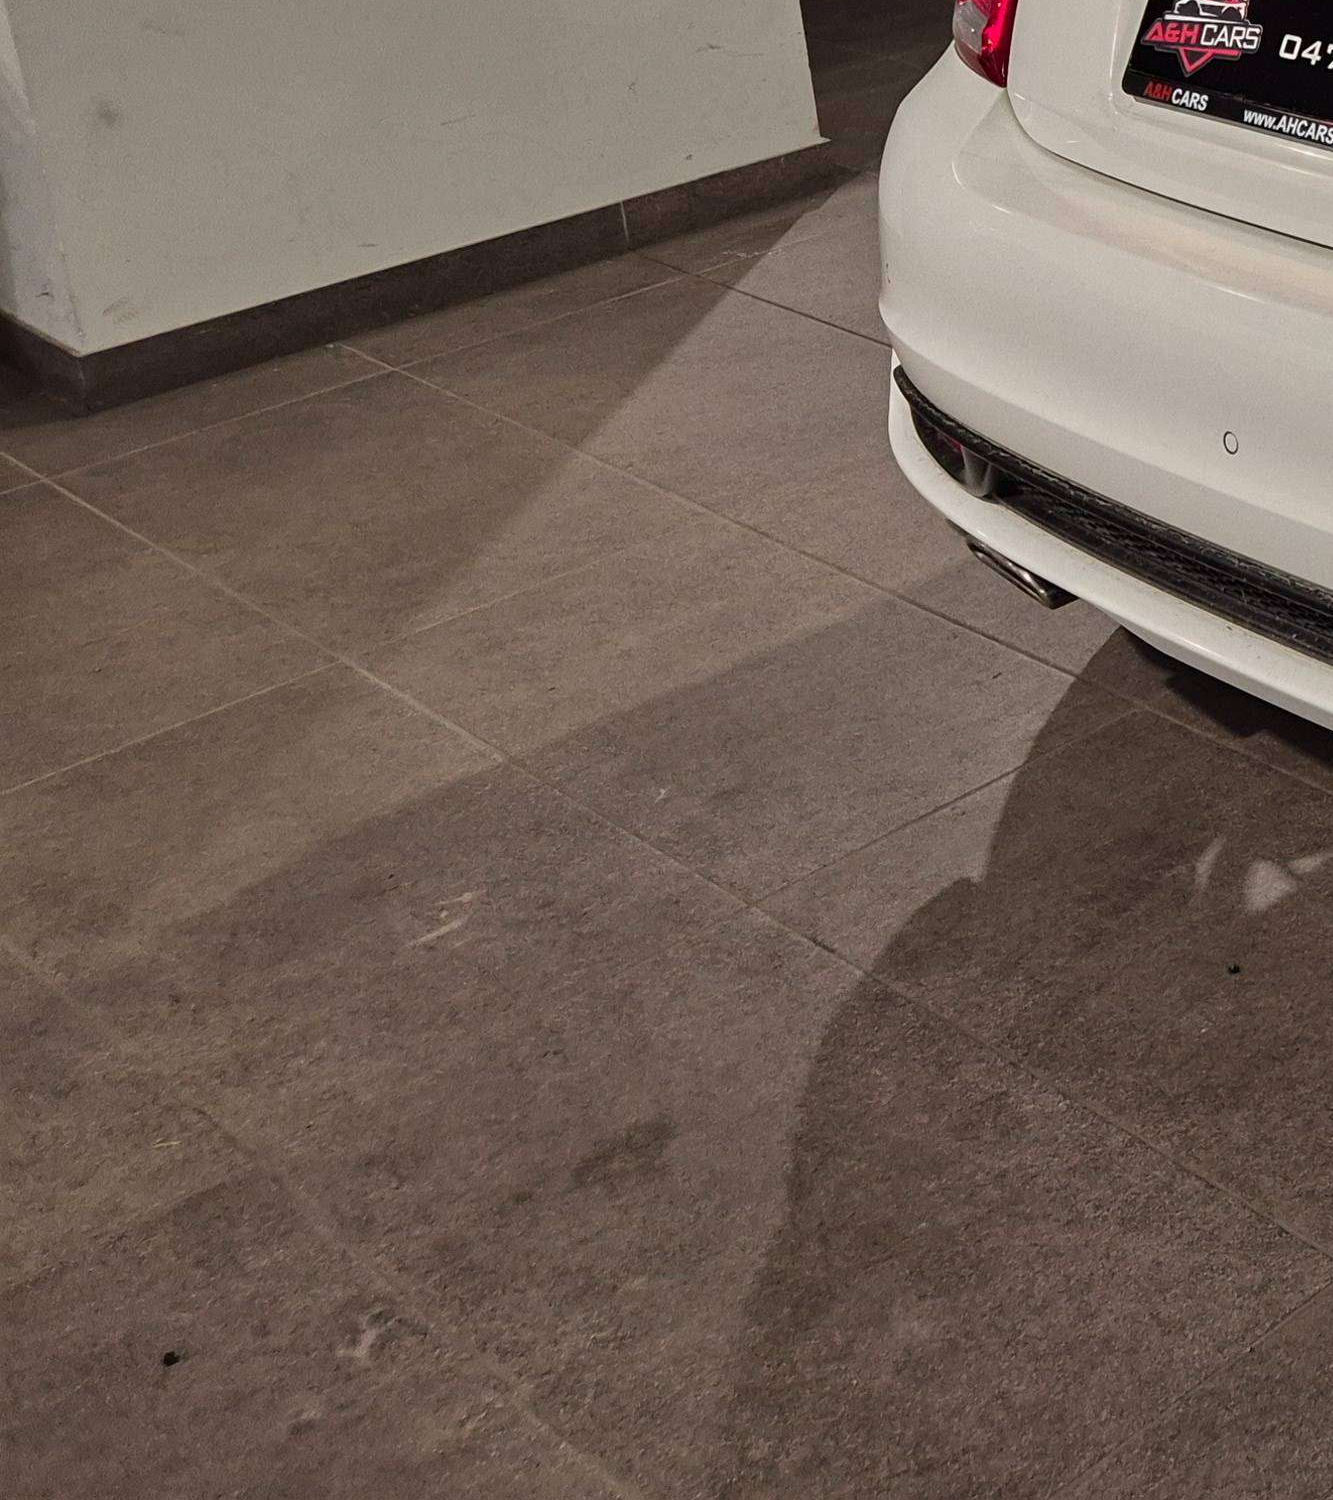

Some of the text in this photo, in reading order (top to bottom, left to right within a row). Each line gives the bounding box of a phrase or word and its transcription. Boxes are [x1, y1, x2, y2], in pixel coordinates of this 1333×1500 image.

[1145, 21, 1261, 50] A&H CARS
[1171, 88, 1209, 112] CARS
